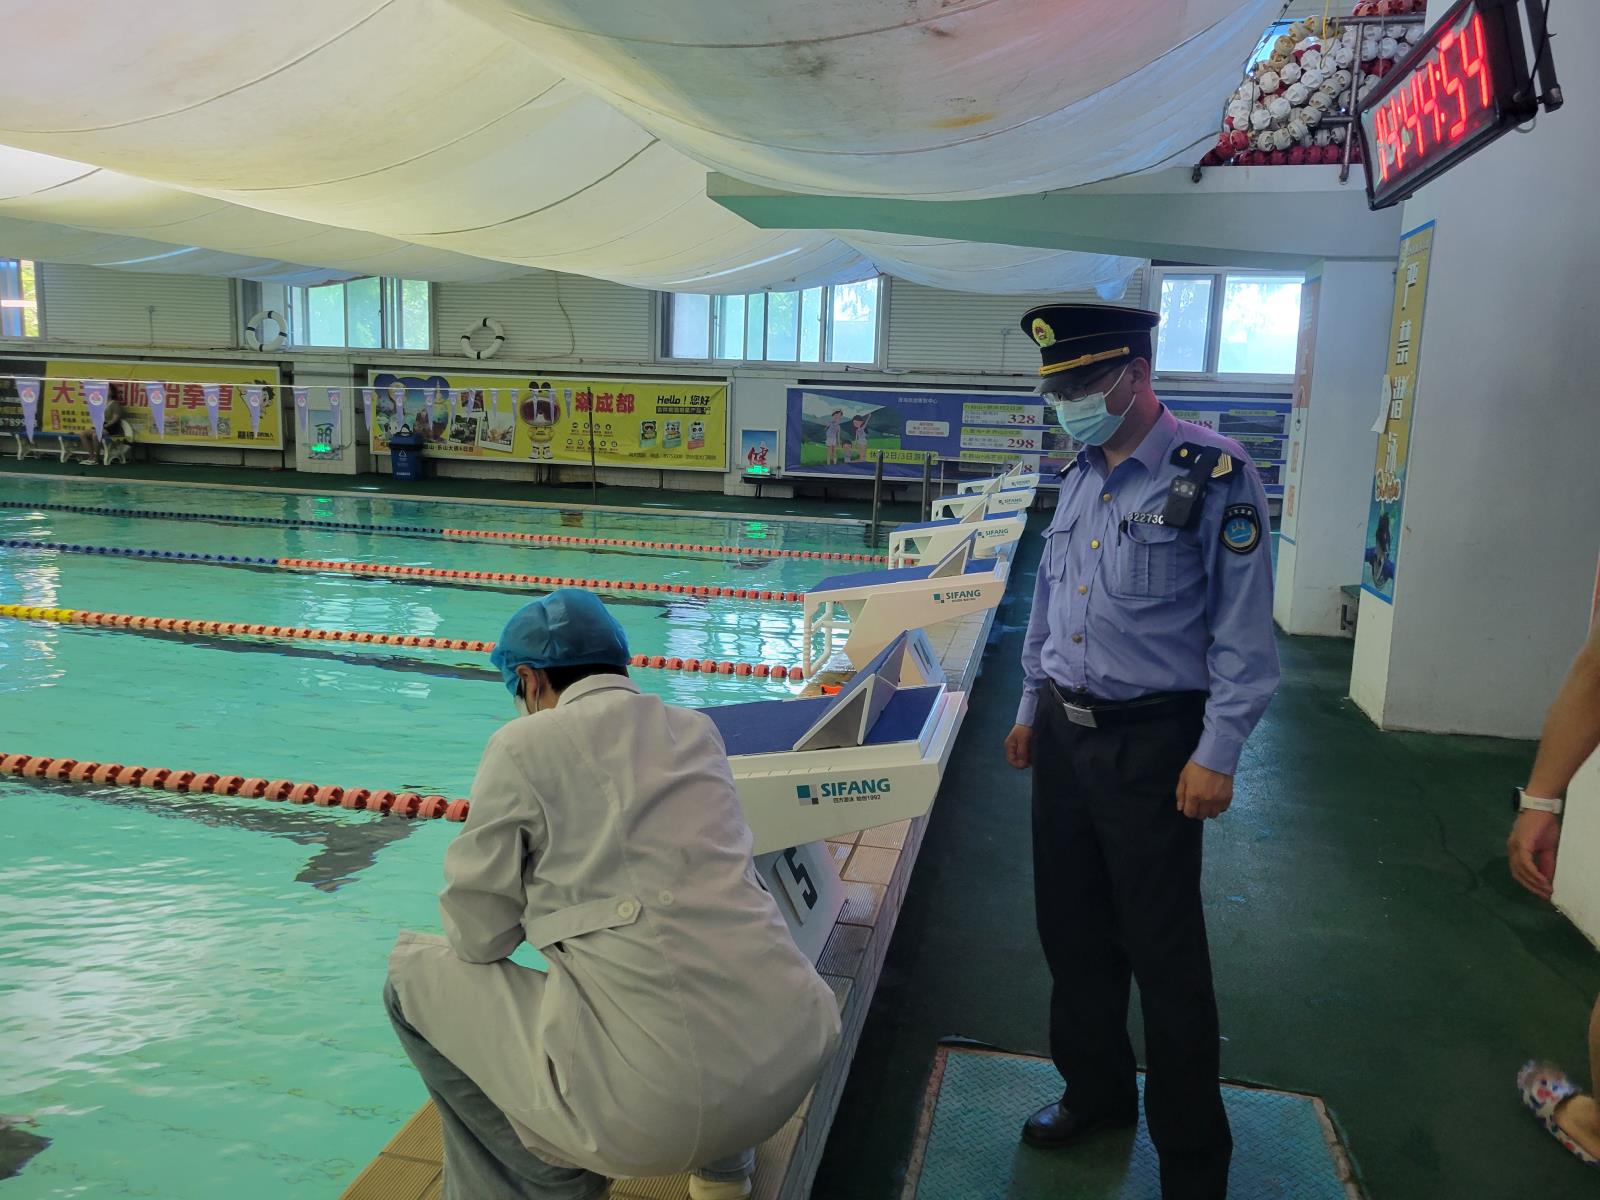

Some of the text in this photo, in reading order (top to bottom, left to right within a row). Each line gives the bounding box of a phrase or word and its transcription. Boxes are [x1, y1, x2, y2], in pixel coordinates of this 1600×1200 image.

[1007, 414, 1036, 425] 328
[1007, 438, 1035, 449] 298
[985, 528, 1009, 536] SIFANG
[945, 589, 981, 600] SIFANG
[821, 778, 891, 797] SIFANG
[783, 846, 818, 910] 5
